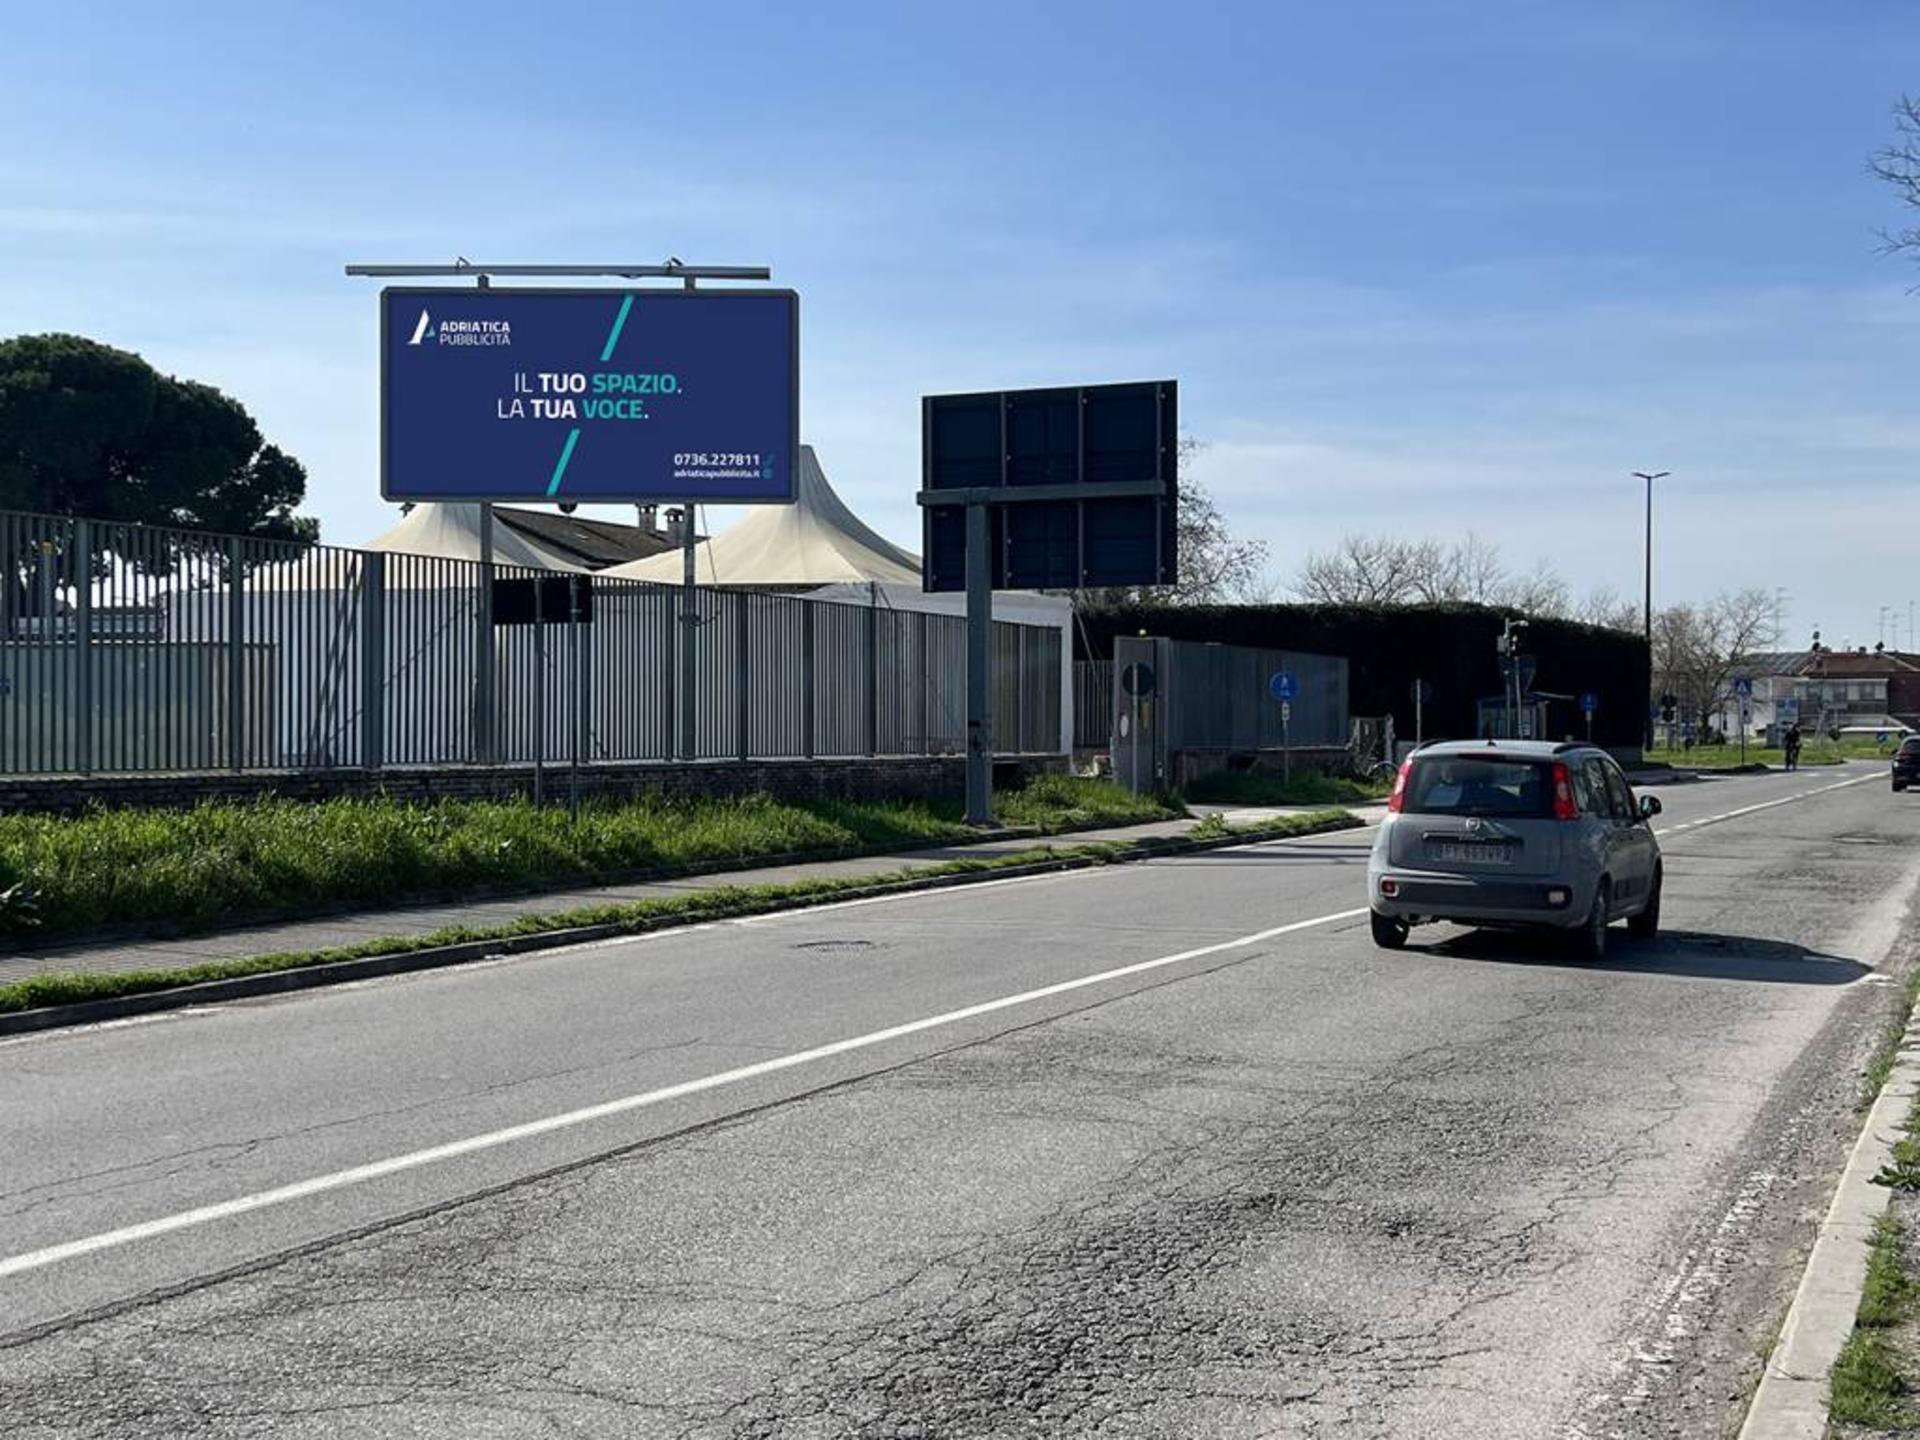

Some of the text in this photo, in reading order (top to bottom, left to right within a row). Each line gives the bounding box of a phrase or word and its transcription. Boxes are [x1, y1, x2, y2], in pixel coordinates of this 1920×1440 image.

[440, 321, 510, 332] ADRIATICA
[440, 332, 510, 345] PUBBLICITÀ
[515, 373, 682, 393] IL TUO SPAZIO.
[498, 398, 649, 419] LA TUA VOCE.
[674, 453, 760, 466] 0736.227811
